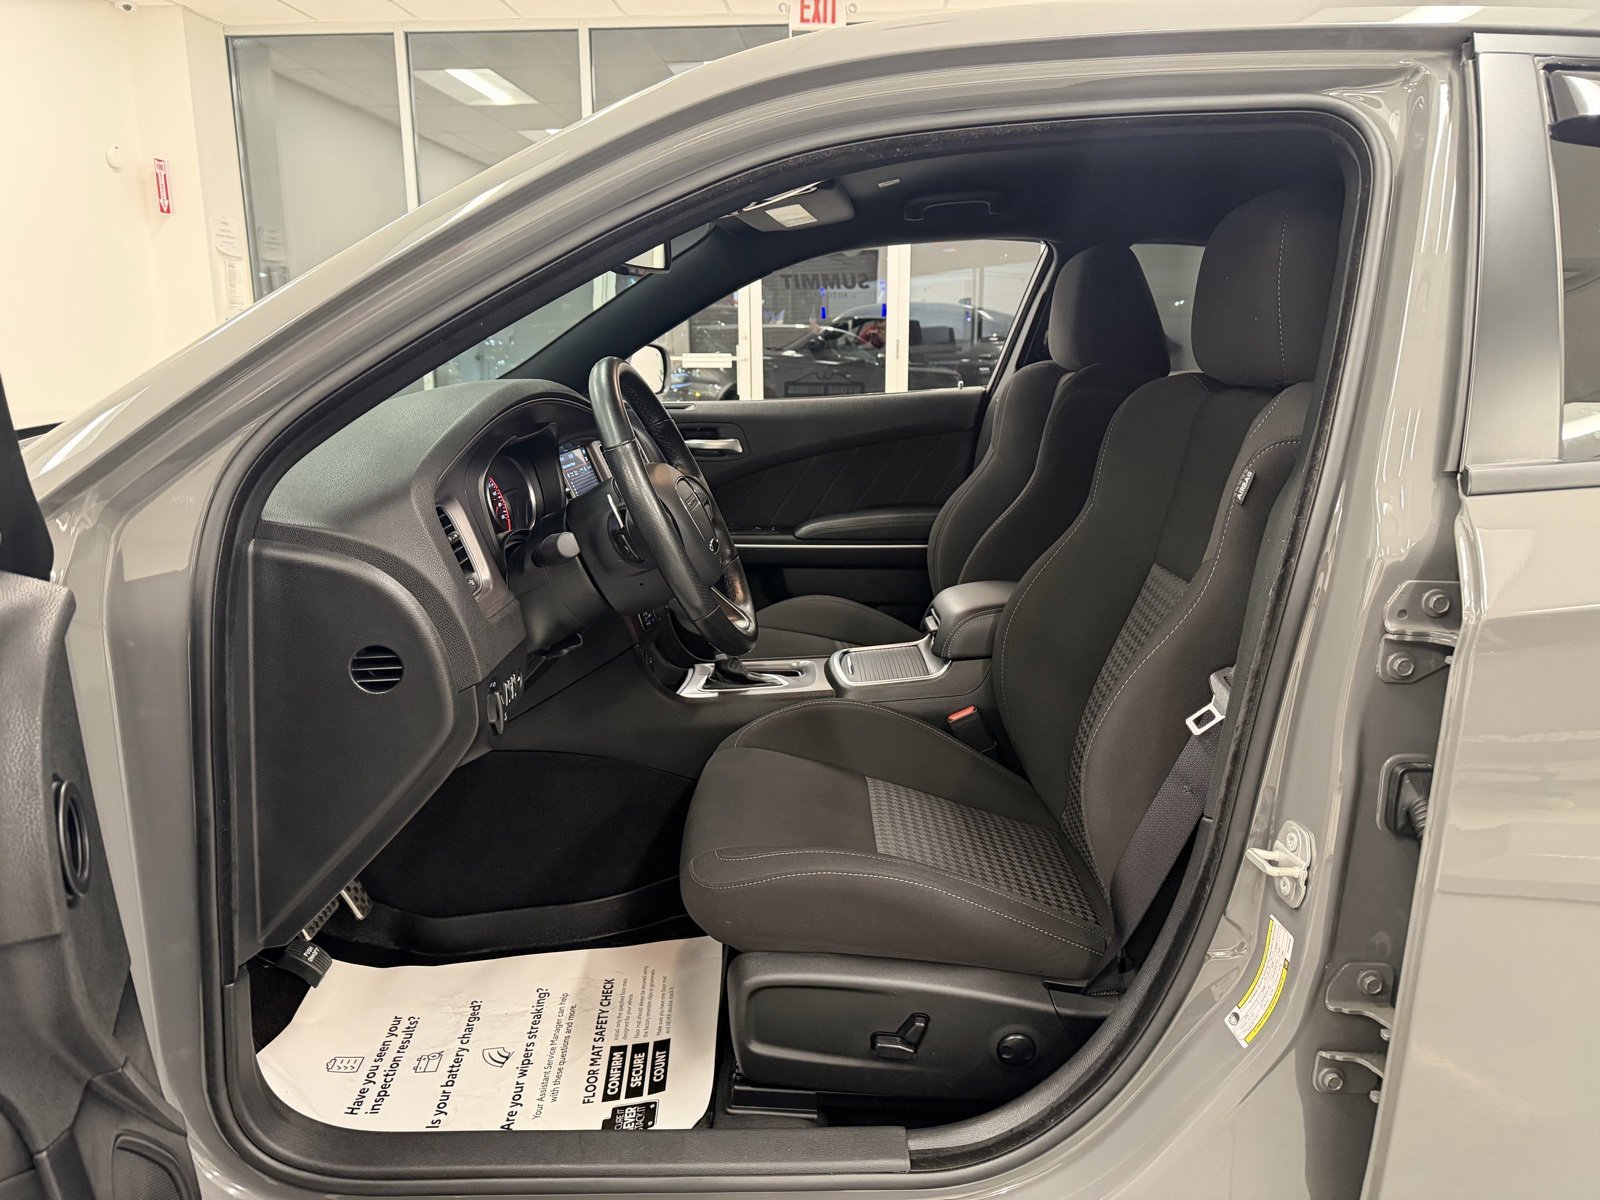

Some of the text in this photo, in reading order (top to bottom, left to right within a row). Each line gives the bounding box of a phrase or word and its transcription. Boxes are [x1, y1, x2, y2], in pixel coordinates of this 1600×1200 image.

[1236, 471, 1252, 500] AIRBAG
[558, 993, 569, 1005] help
[568, 1004, 576, 1020] more.
[550, 1019, 563, 1045] Manager
[582, 979, 615, 1104] FLOOR MAT SAFETY CHECK
[344, 1016, 402, 1115] Have you seen your
[364, 1016, 420, 1114] inspection results?
[425, 1001, 483, 1128] Is your battery charged?
[500, 988, 550, 1130] Are your wipers streaking?
[544, 1047, 556, 1069] Service
[559, 1036, 570, 1066] questions
[553, 1067, 563, 1085] these
[606, 1052, 624, 1095] CONFIRM
[630, 1052, 646, 1087] SECURE
[653, 1051, 666, 1082] COUNT
[537, 1071, 551, 1101] Assistant
[550, 1087, 559, 1102] with
[532, 1104, 543, 1120] Your
[615, 1115, 624, 1130] CURE
